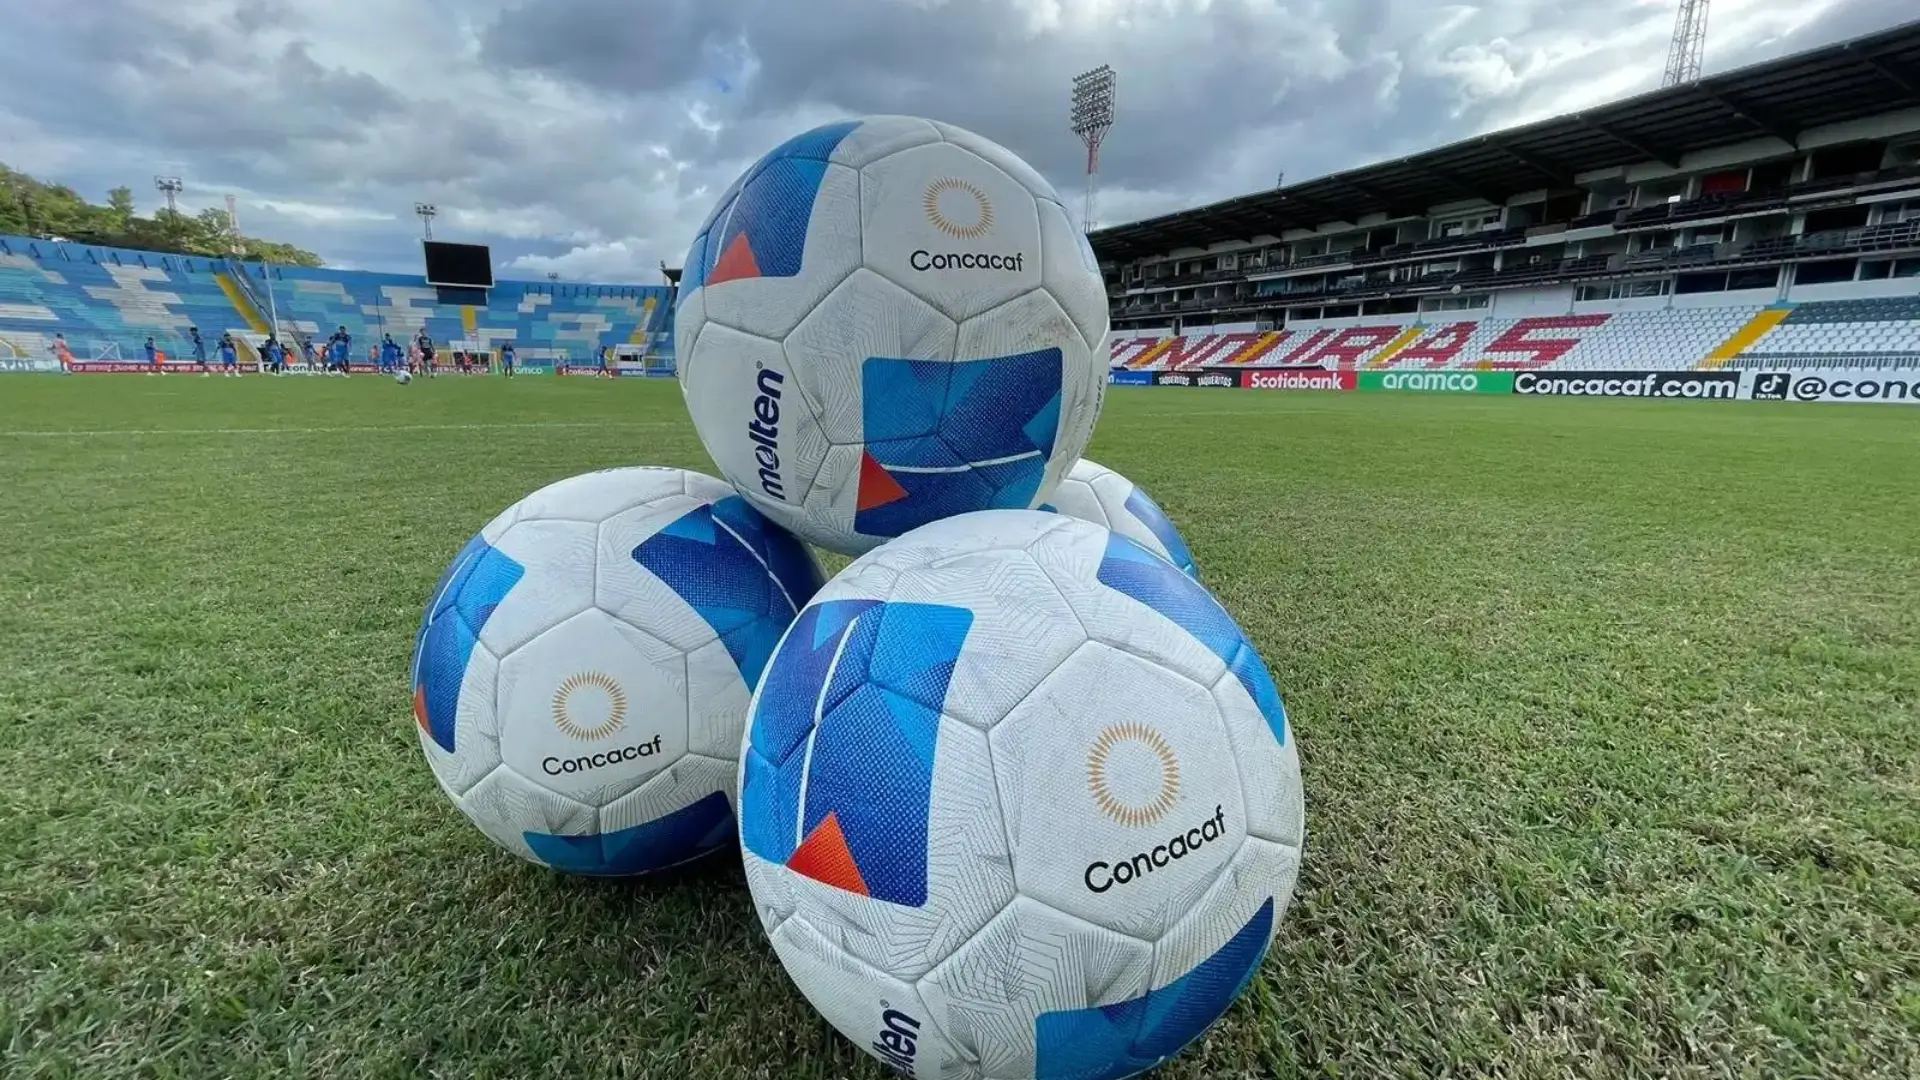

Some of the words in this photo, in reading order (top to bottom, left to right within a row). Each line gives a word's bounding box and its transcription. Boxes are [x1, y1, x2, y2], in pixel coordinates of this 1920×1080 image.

[909, 249, 1024, 273] Concacaf
[1250, 372, 1343, 390] Scotiabank
[1382, 373, 1478, 391] aramco
[1514, 373, 1736, 399] Concacaf.com
[749, 368, 786, 500] molten
[541, 734, 663, 776] Concacaf
[1084, 804, 1227, 894] Concacaf
